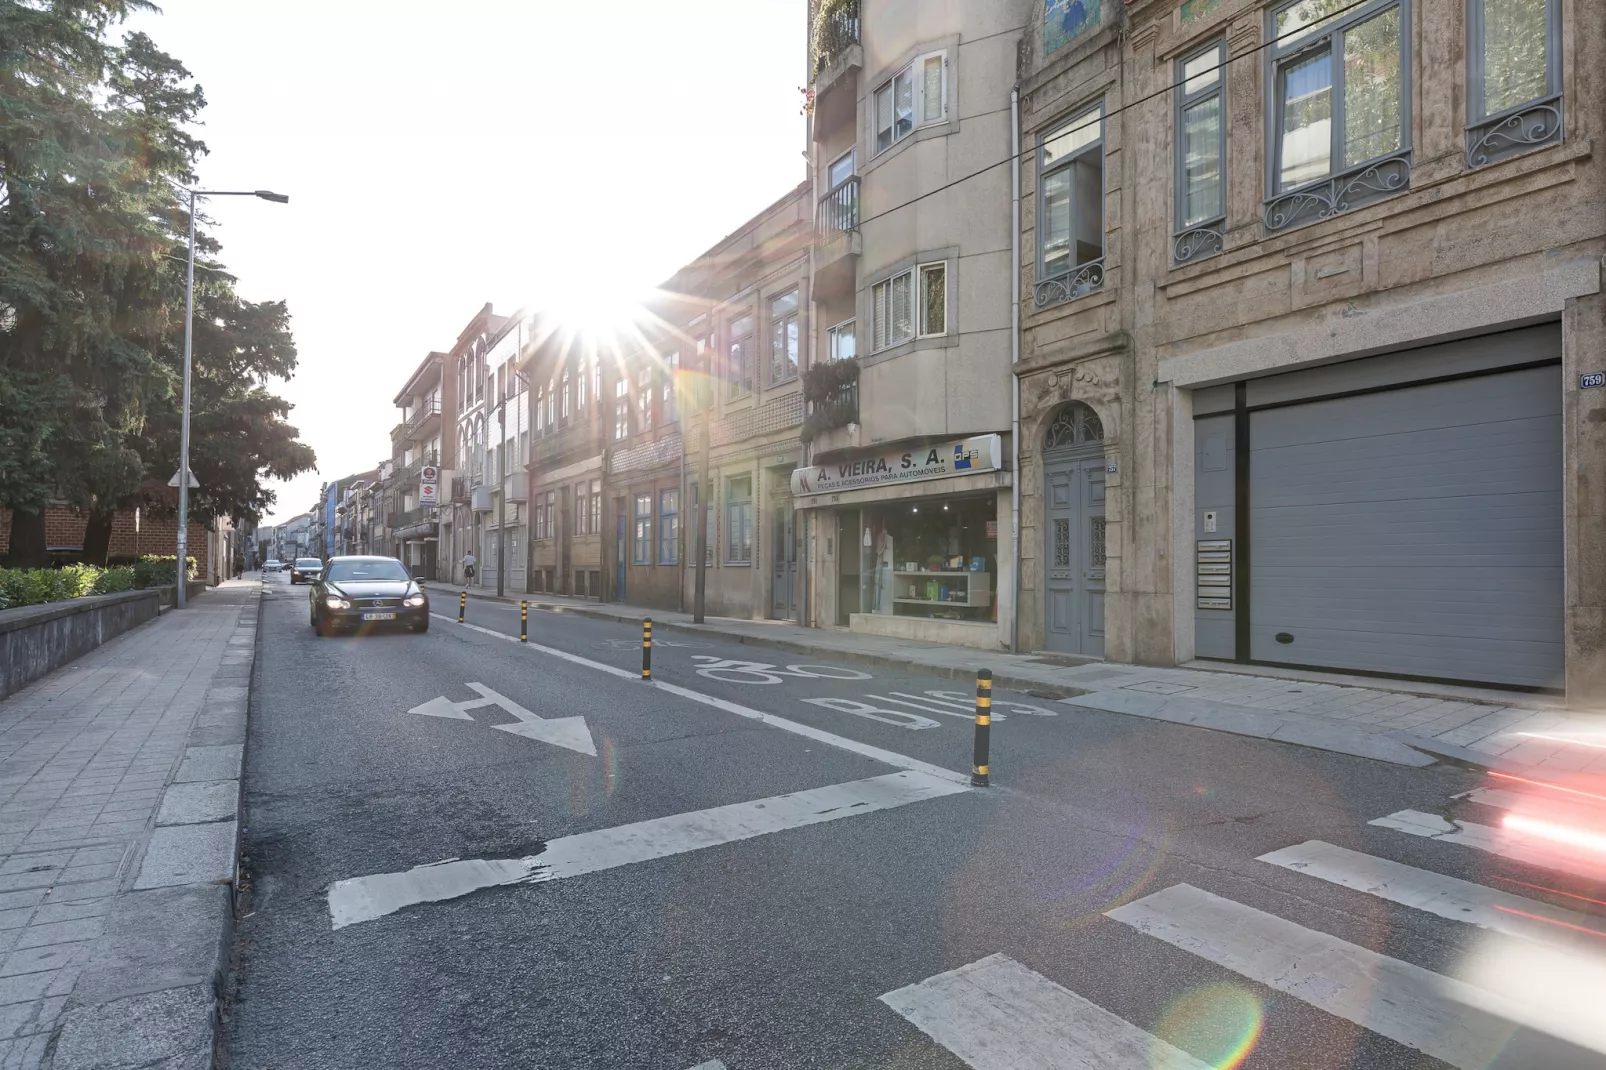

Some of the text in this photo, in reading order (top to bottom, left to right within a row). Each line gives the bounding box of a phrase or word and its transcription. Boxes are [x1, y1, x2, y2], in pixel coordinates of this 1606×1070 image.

[1583, 375, 1602, 386] 759
[817, 448, 945, 482] A. VIEIRA, S. A.
[817, 480, 836, 490] PEÇAS
[880, 473, 898, 481] PARA
[899, 466, 946, 478] AUTOMÓVEIS
[800, 690, 1059, 731] BUS
